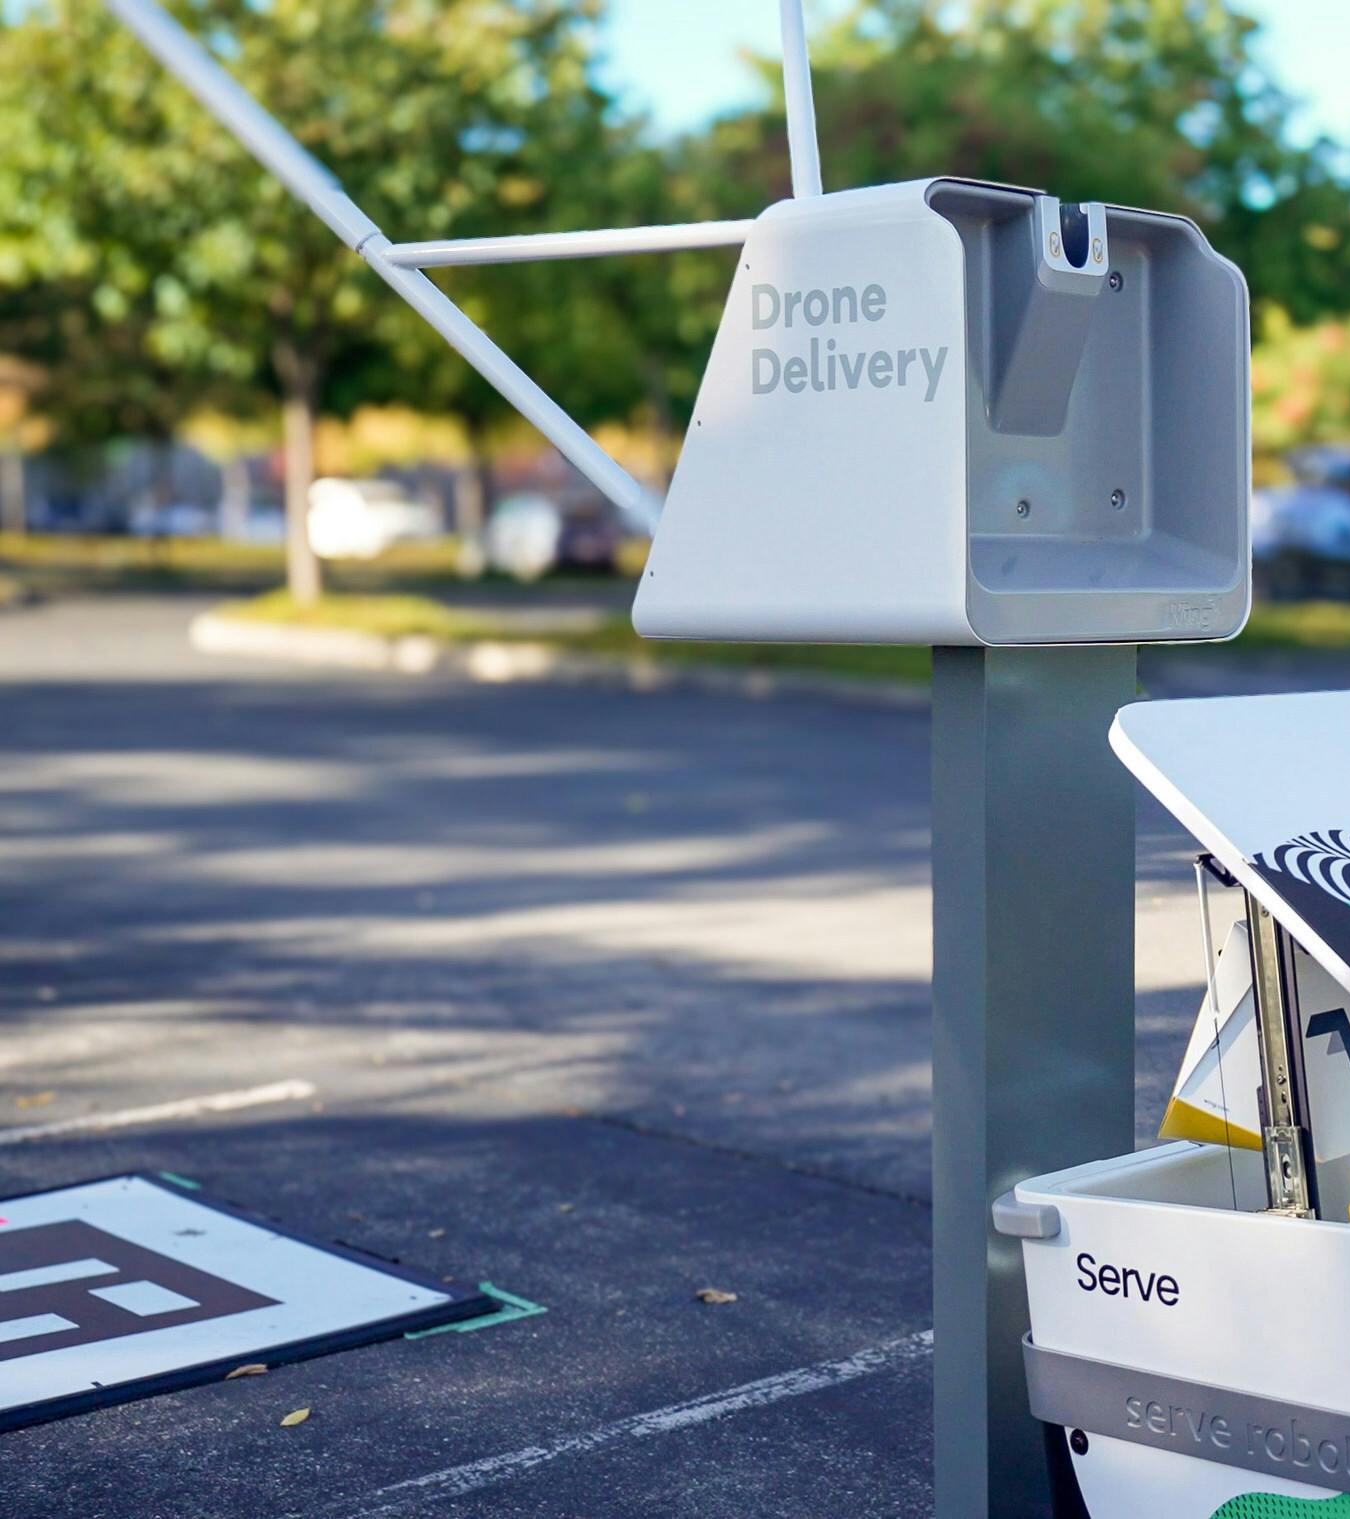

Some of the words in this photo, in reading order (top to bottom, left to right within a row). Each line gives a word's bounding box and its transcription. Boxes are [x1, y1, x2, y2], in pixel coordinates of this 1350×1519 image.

[751, 283, 887, 330] Drone
[751, 337, 949, 402] Delivery
[1076, 1252, 1180, 1306] Serve
[1125, 1395, 1232, 1449] serve
